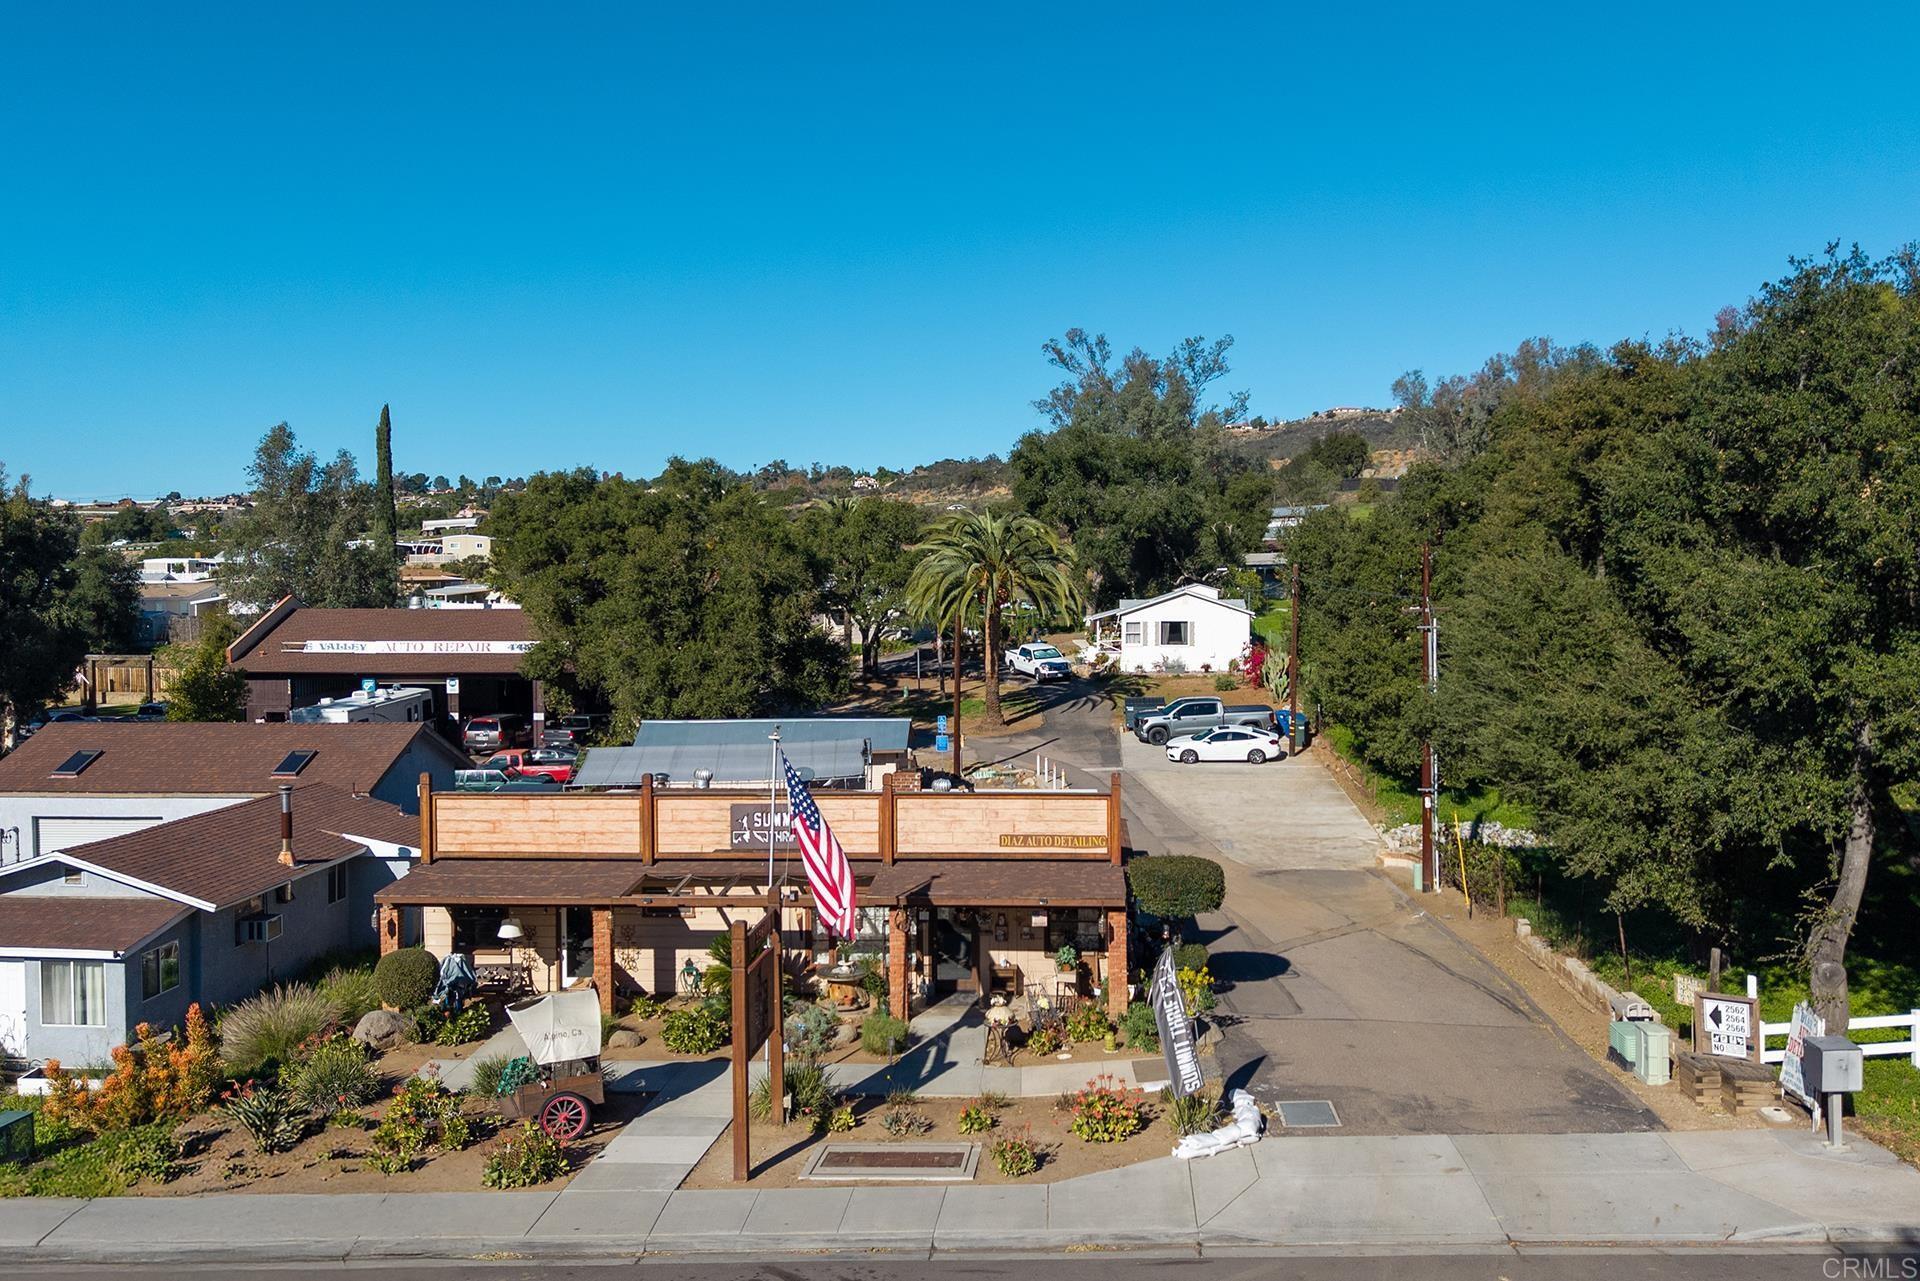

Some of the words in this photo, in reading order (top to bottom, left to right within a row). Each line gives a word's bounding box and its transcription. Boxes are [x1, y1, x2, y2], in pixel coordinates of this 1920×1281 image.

[320, 643, 367, 651] VALLEY
[384, 642, 424, 652] AUTO
[434, 642, 491, 652] REPAIR
[753, 812, 790, 828] SUMM
[1001, 835, 1025, 847] DIAZ
[1026, 835, 1053, 847] AUTO
[1054, 835, 1106, 847] DETAILING
[1162, 990, 1187, 1040] THRIFT
[1725, 1004, 1745, 1015] 2562
[1725, 1014, 1745, 1024] 2564
[1726, 1023, 1746, 1034] 2566
[1713, 1043, 1725, 1052] NO
[1174, 1039, 1200, 1093] SUMMIT
